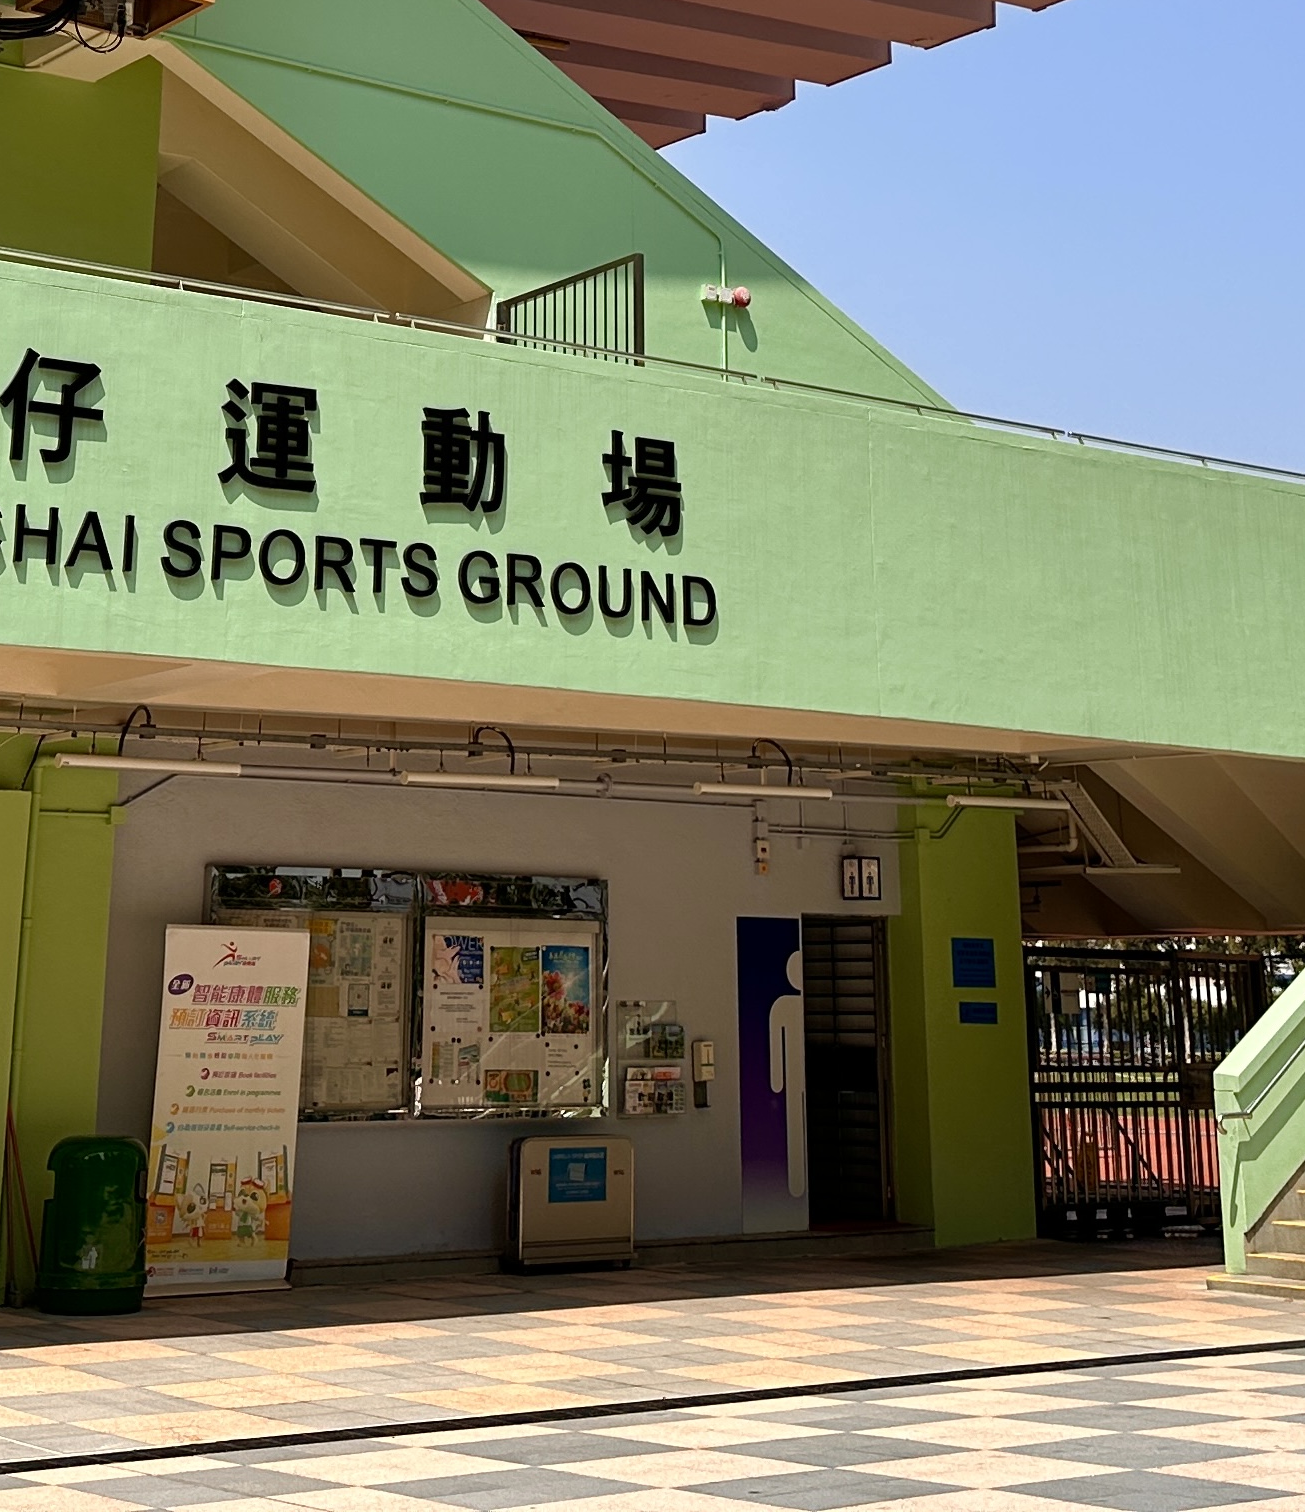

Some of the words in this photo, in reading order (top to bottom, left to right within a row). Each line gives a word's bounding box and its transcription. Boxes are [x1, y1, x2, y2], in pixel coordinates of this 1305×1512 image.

[160, 520, 438, 599] SPORTS
[457, 549, 717, 627] GROUND
[192, 983, 301, 1006] 智能康體服務
[170, 1007, 278, 1030] 預訂資訊系統
